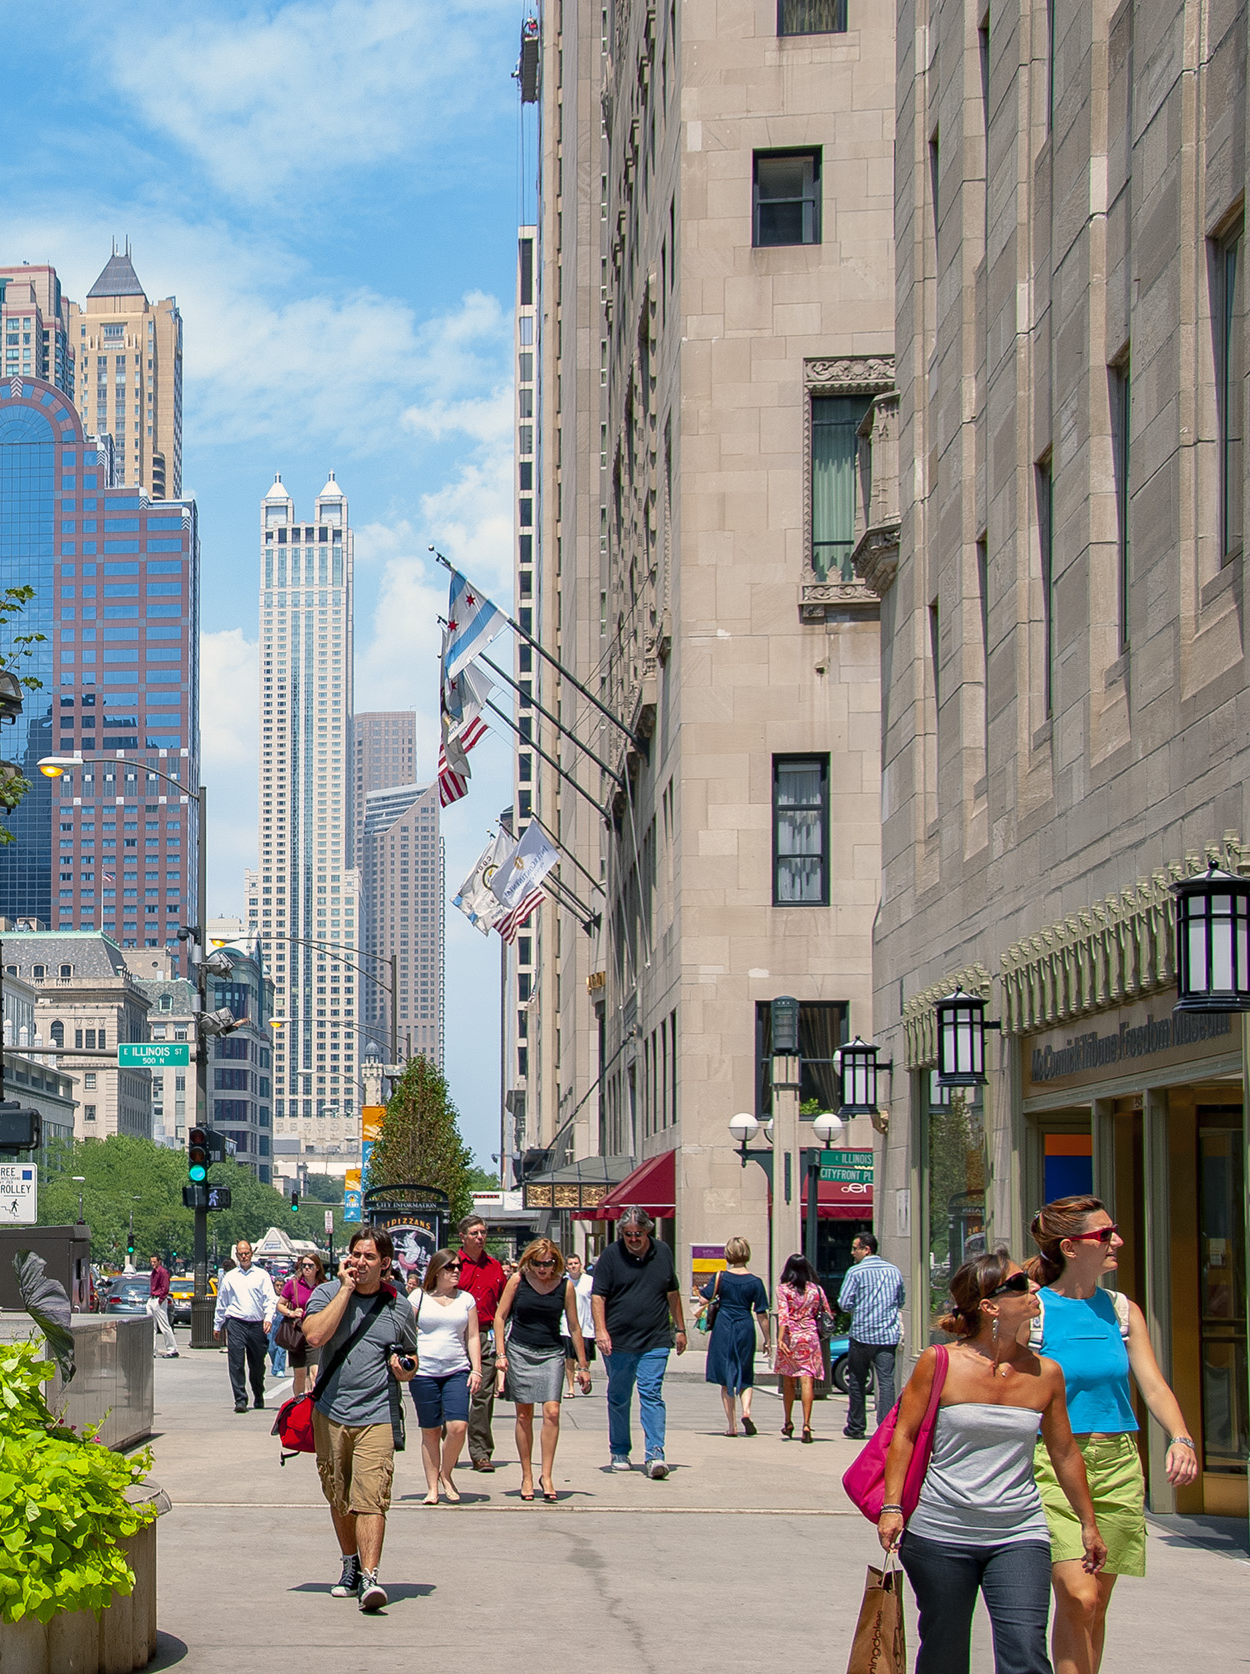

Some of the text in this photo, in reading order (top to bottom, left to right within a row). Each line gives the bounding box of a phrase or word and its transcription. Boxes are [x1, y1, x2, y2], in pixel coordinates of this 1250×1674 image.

[1119, 1014, 1172, 1061] Freedom
[132, 1047, 170, 1057] ILLINOIS
[841, 1153, 873, 1165] ILLINOIS
[820, 1168, 861, 1181] CITYFRONT
[393, 1201, 437, 1209] INFORMATION
[381, 1217, 431, 1230] LIPIZZANS
